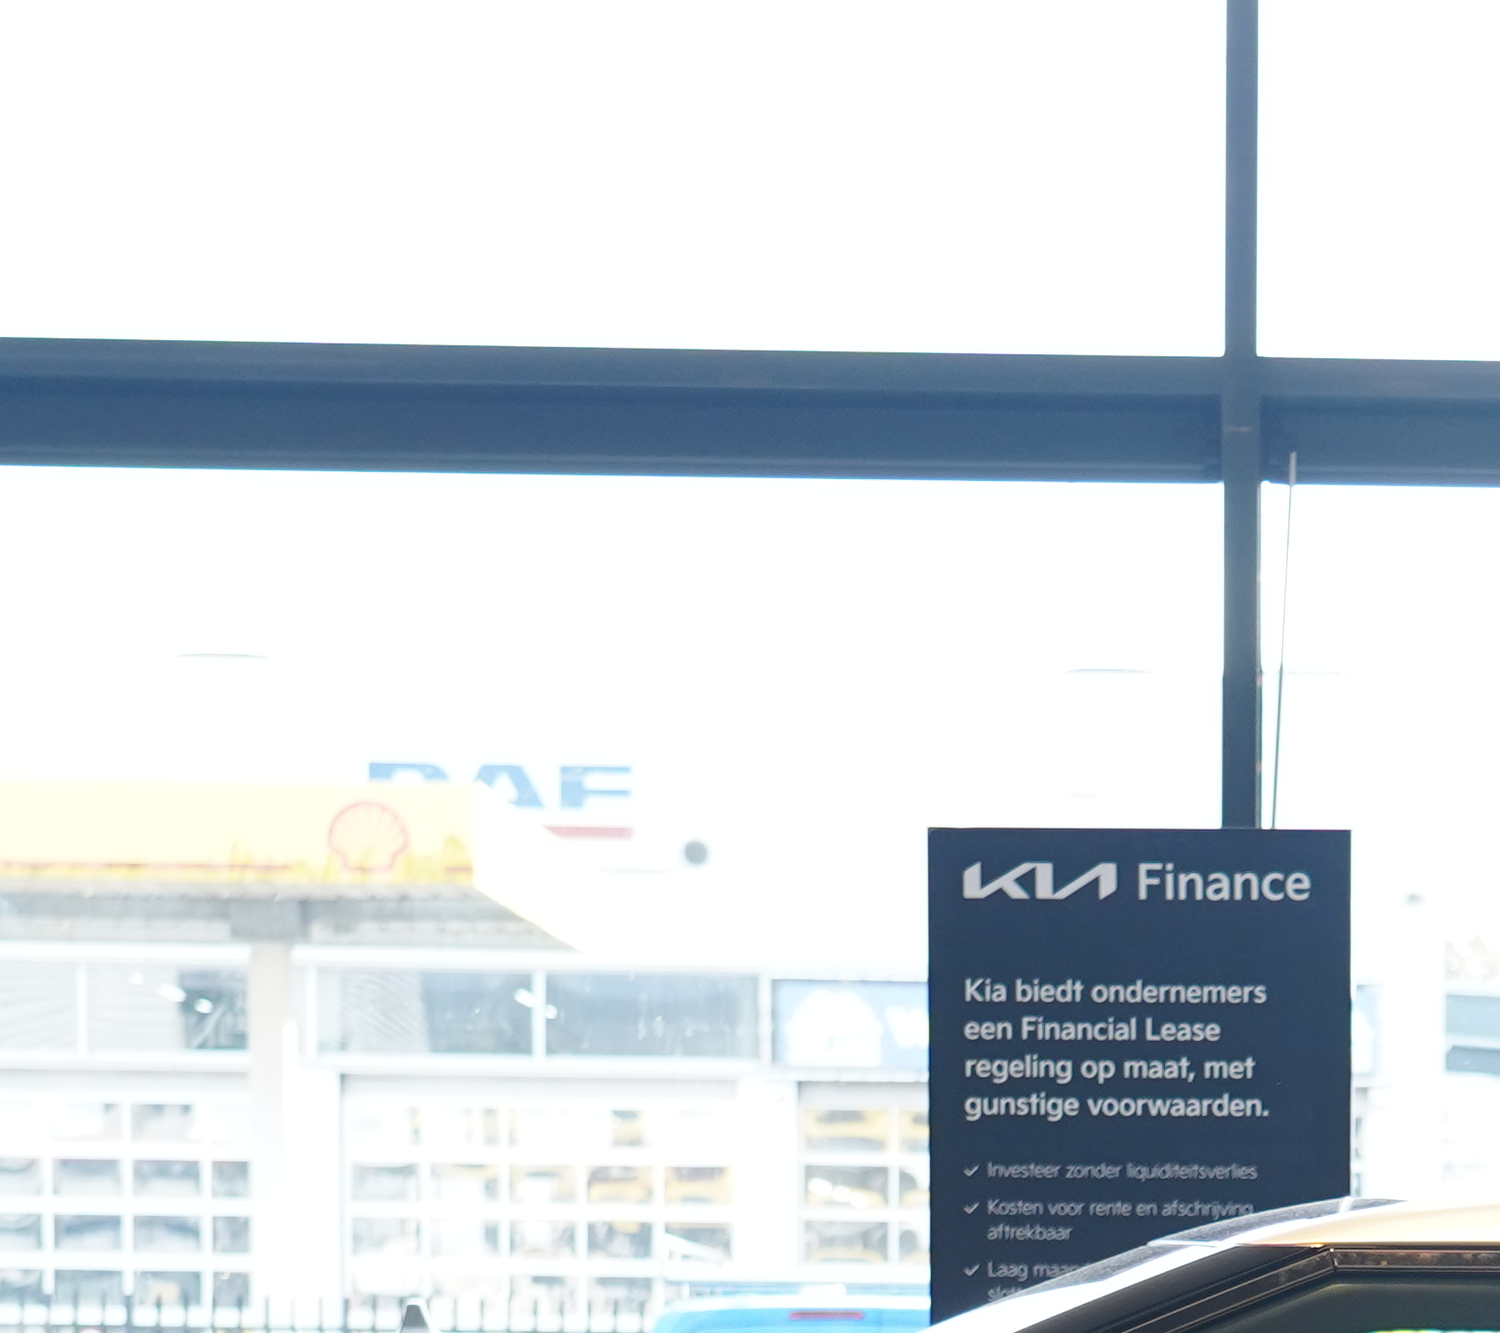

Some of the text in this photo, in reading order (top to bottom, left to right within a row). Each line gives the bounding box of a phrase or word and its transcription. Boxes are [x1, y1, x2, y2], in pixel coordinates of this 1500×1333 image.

[962, 861, 1313, 901] KIA Finance
[964, 979, 1267, 1004] Kia biedt ondernemers
[964, 1016, 1221, 1042] een Financial Lease
[965, 1055, 1256, 1084] regeling op maat, met
[964, 1094, 1269, 1121] gunstige voorwaarden.
[987, 1161, 1061, 1179] Investeer
[1065, 1163, 1122, 1179] zonder
[987, 1199, 1043, 1216] Kosten
[1047, 1202, 1085, 1216] voor
[1089, 1201, 1133, 1216] rente
[1136, 1203, 1158, 1216] en
[987, 1224, 1073, 1241] aftrekbaar
[987, 1261, 1028, 1282] Laag
